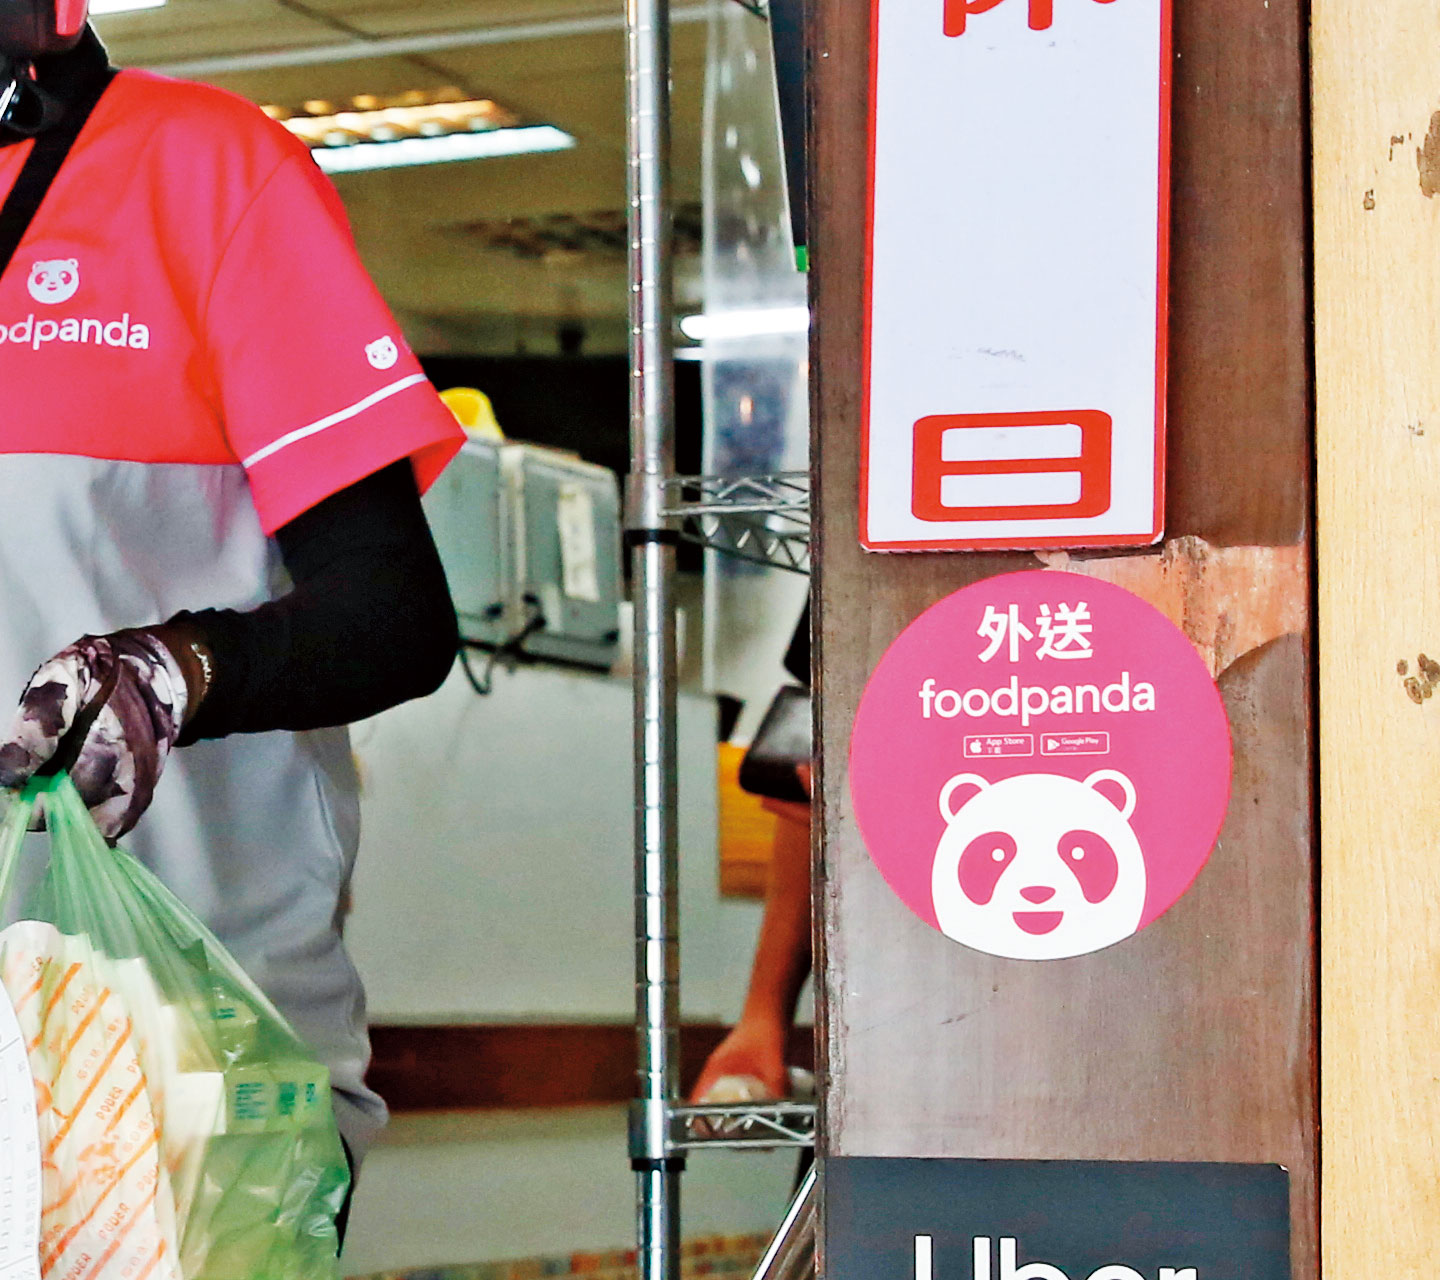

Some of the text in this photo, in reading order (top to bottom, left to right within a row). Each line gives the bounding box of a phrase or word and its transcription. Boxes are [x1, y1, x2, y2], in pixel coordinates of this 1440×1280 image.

[911, 409, 1113, 522] 日
[976, 601, 1094, 664] 外送
[918, 671, 1156, 727] foodpanda
